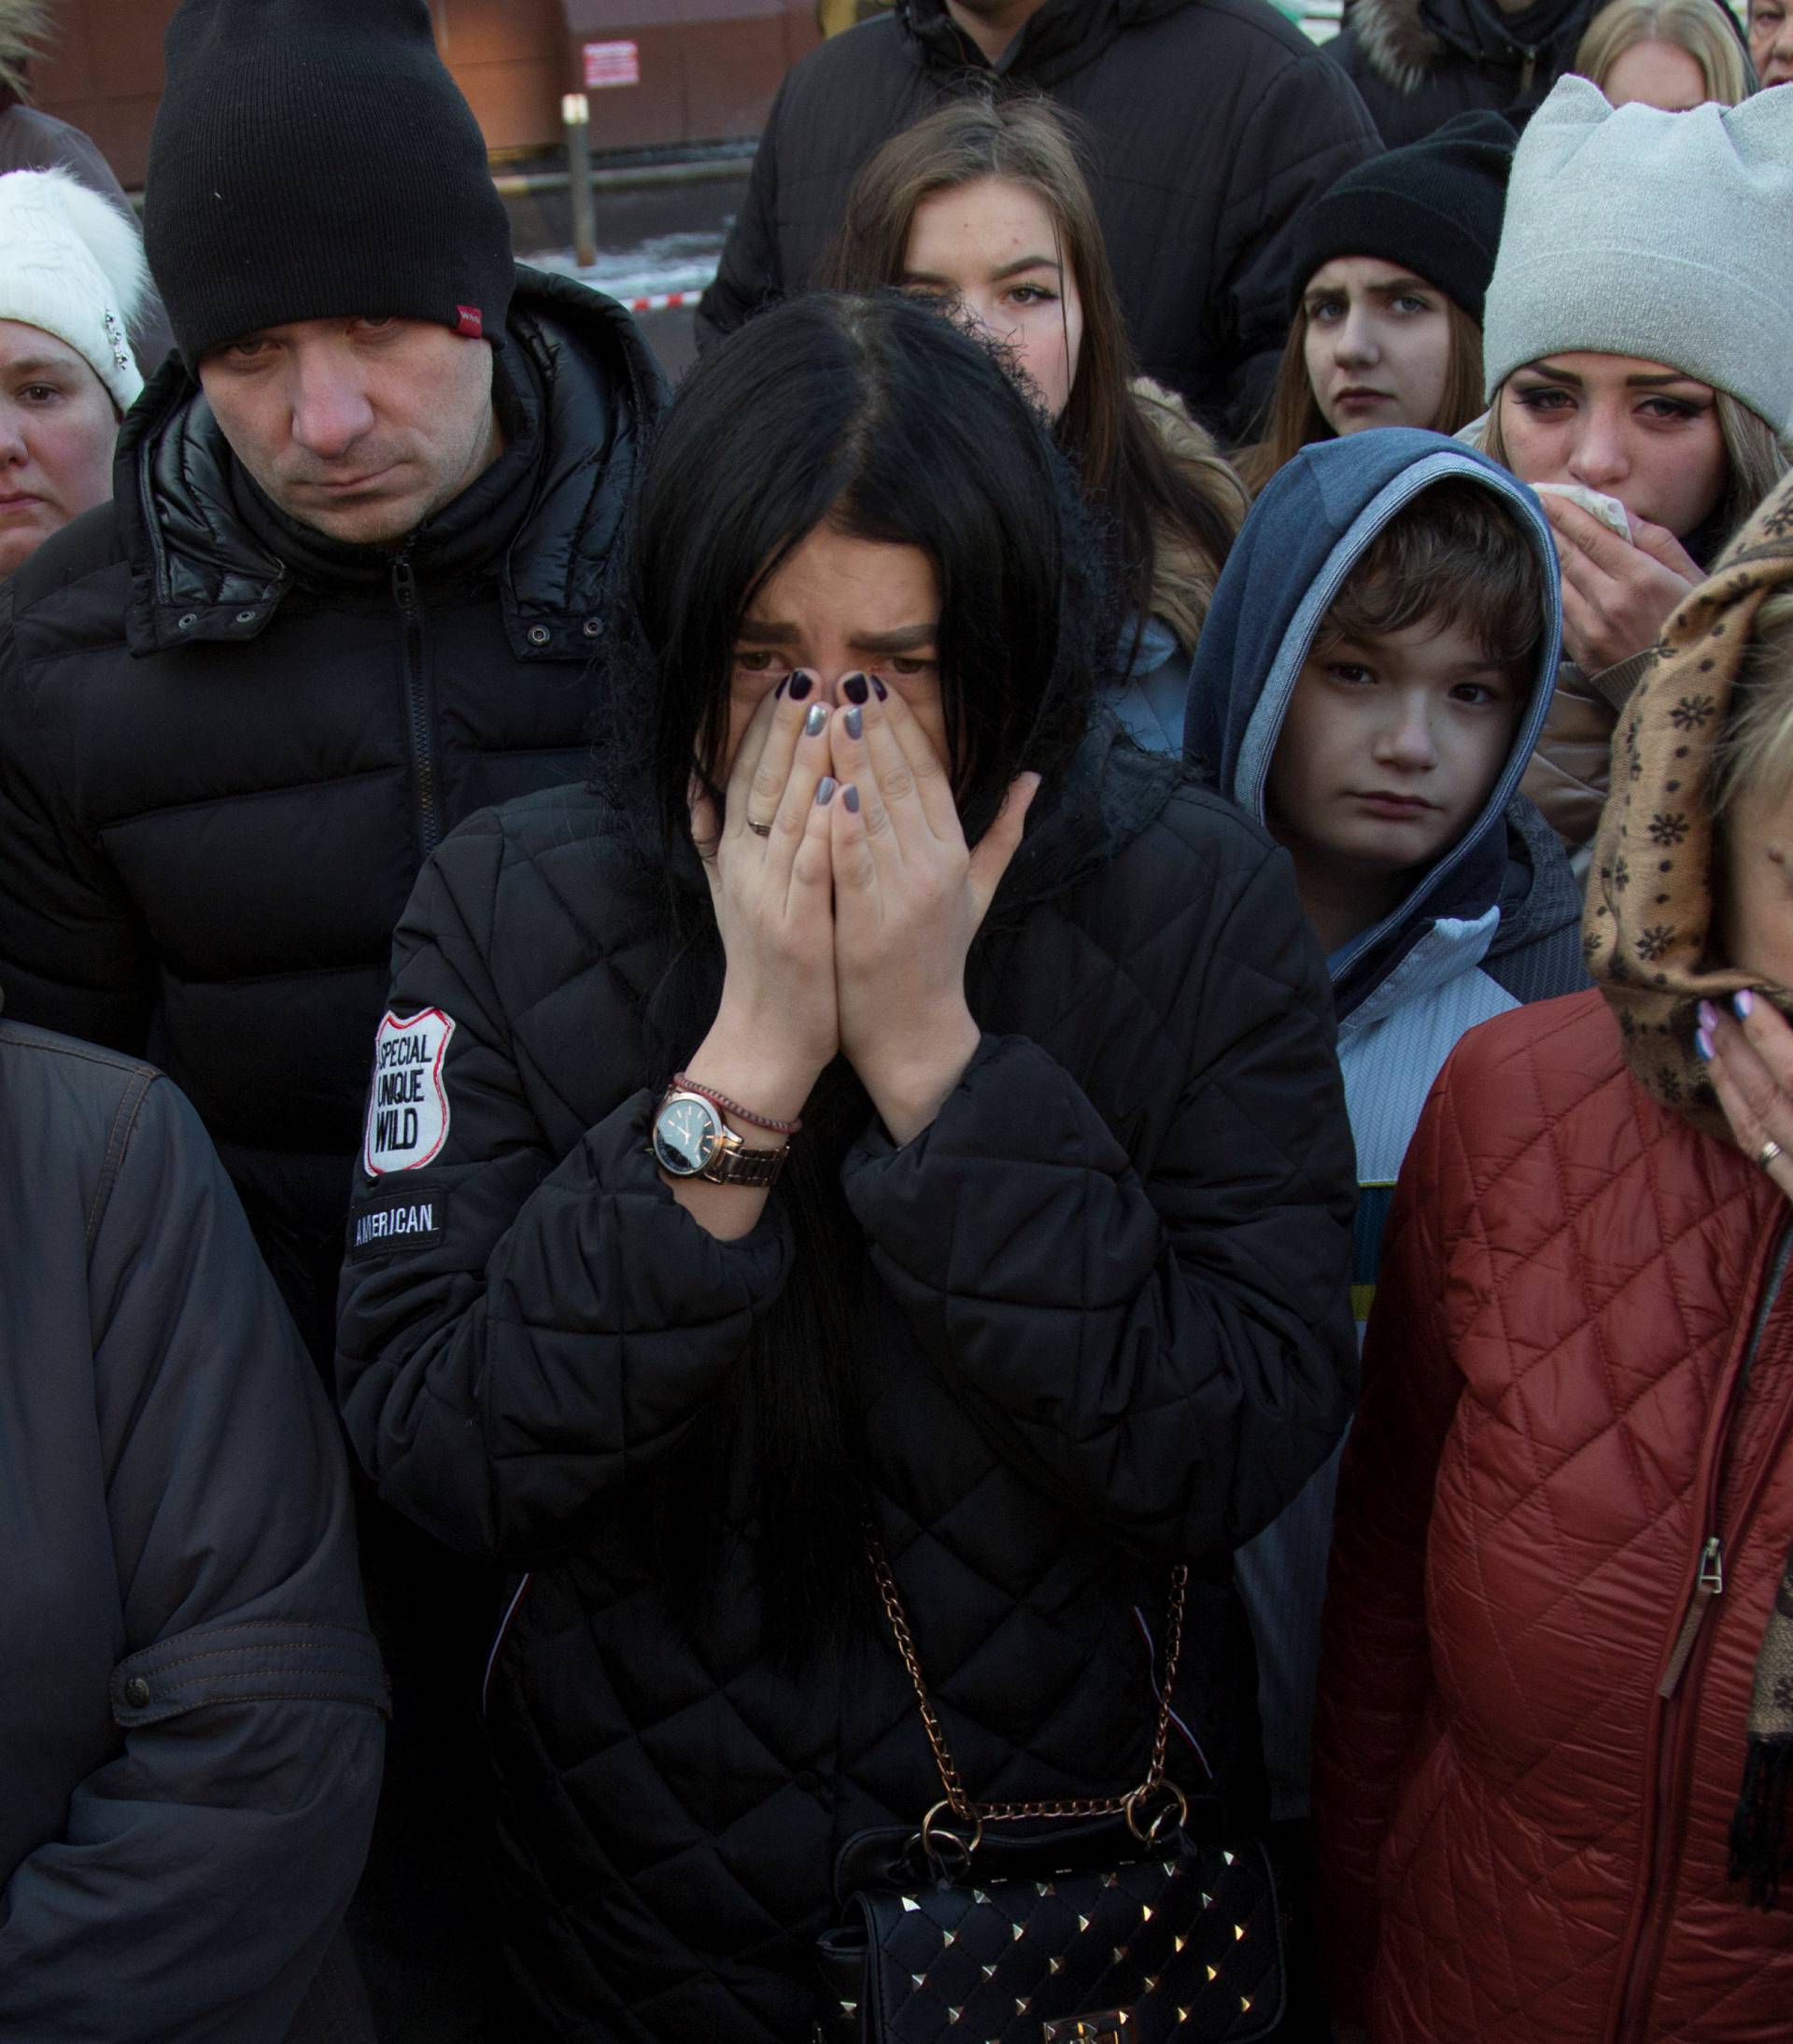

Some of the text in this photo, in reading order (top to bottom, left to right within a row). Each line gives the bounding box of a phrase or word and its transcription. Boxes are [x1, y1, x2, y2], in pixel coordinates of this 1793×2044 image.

[378, 1035, 432, 1070] SPECIAL
[375, 1107, 417, 1153] WILD
[355, 1204, 433, 1246] AMERICAN
